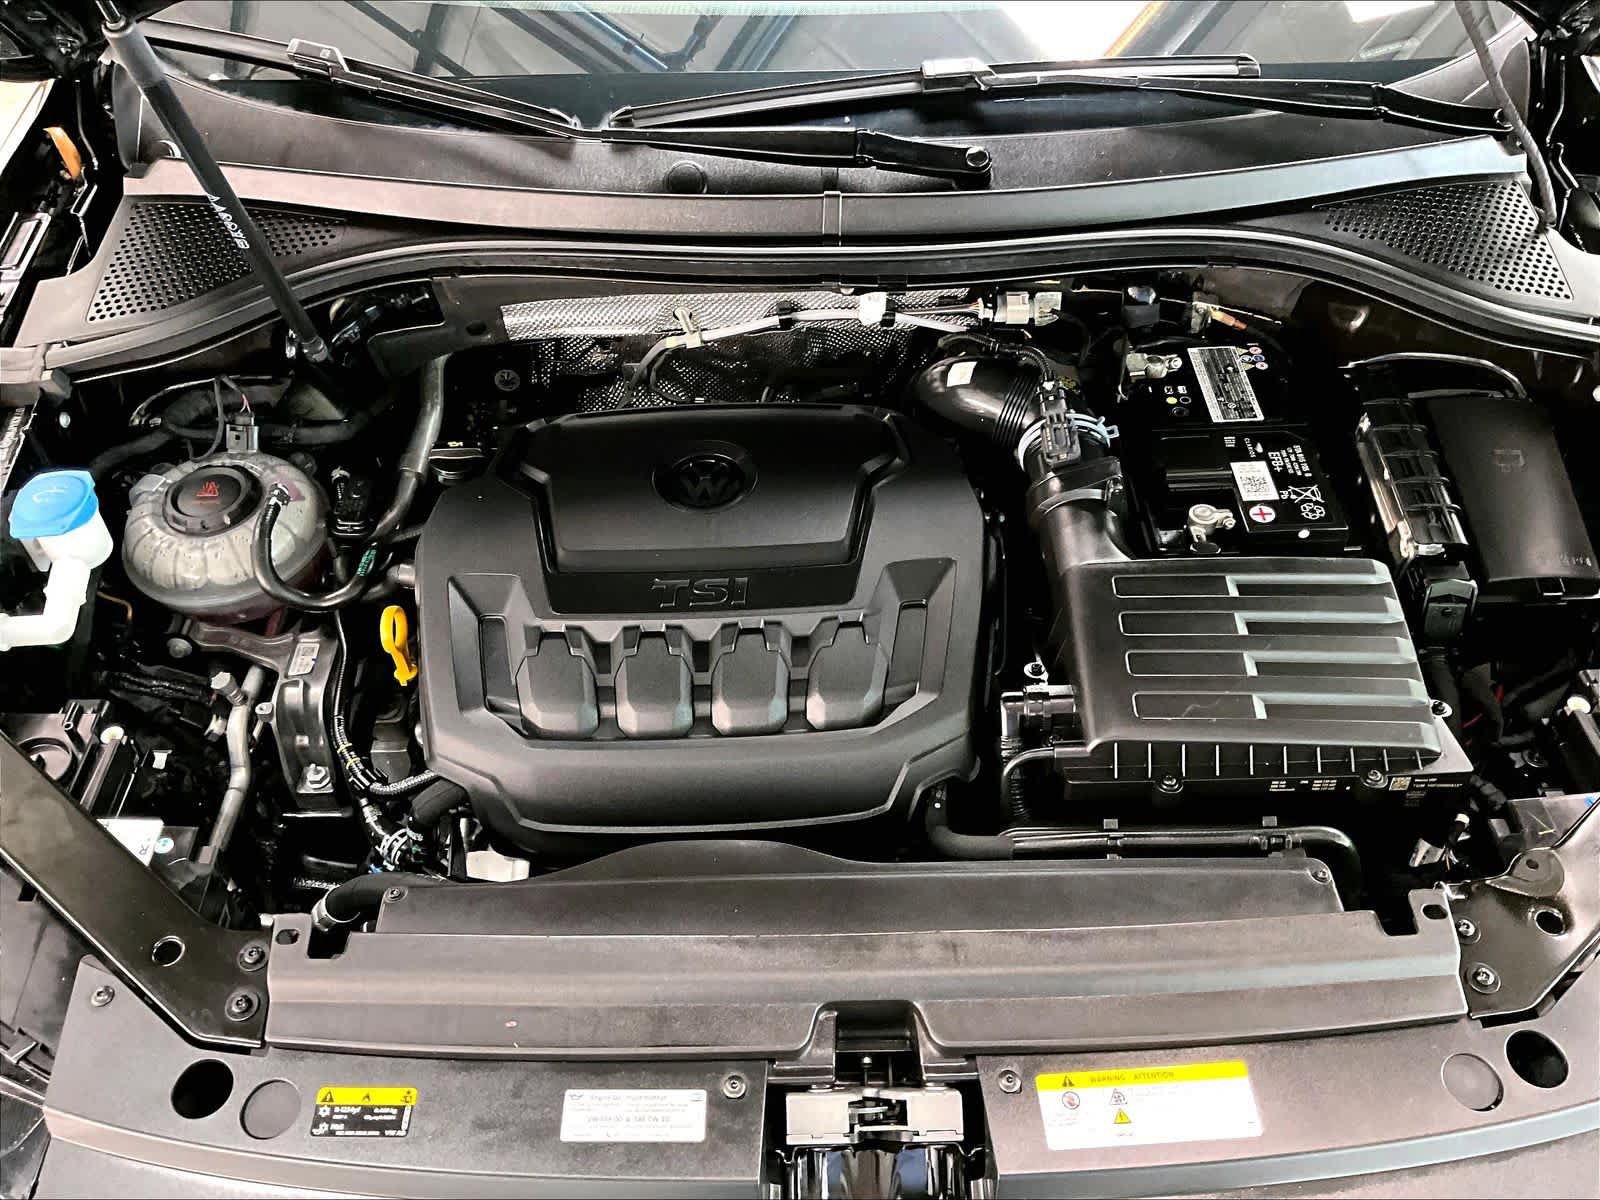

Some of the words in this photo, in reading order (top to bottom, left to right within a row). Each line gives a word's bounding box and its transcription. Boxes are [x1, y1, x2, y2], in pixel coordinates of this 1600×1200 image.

[1267, 451, 1284, 473] EFB+
[651, 577, 749, 608] TSI
[1090, 1074, 1127, 1083] WARNING
[1133, 1071, 1175, 1081] ATTENTION
